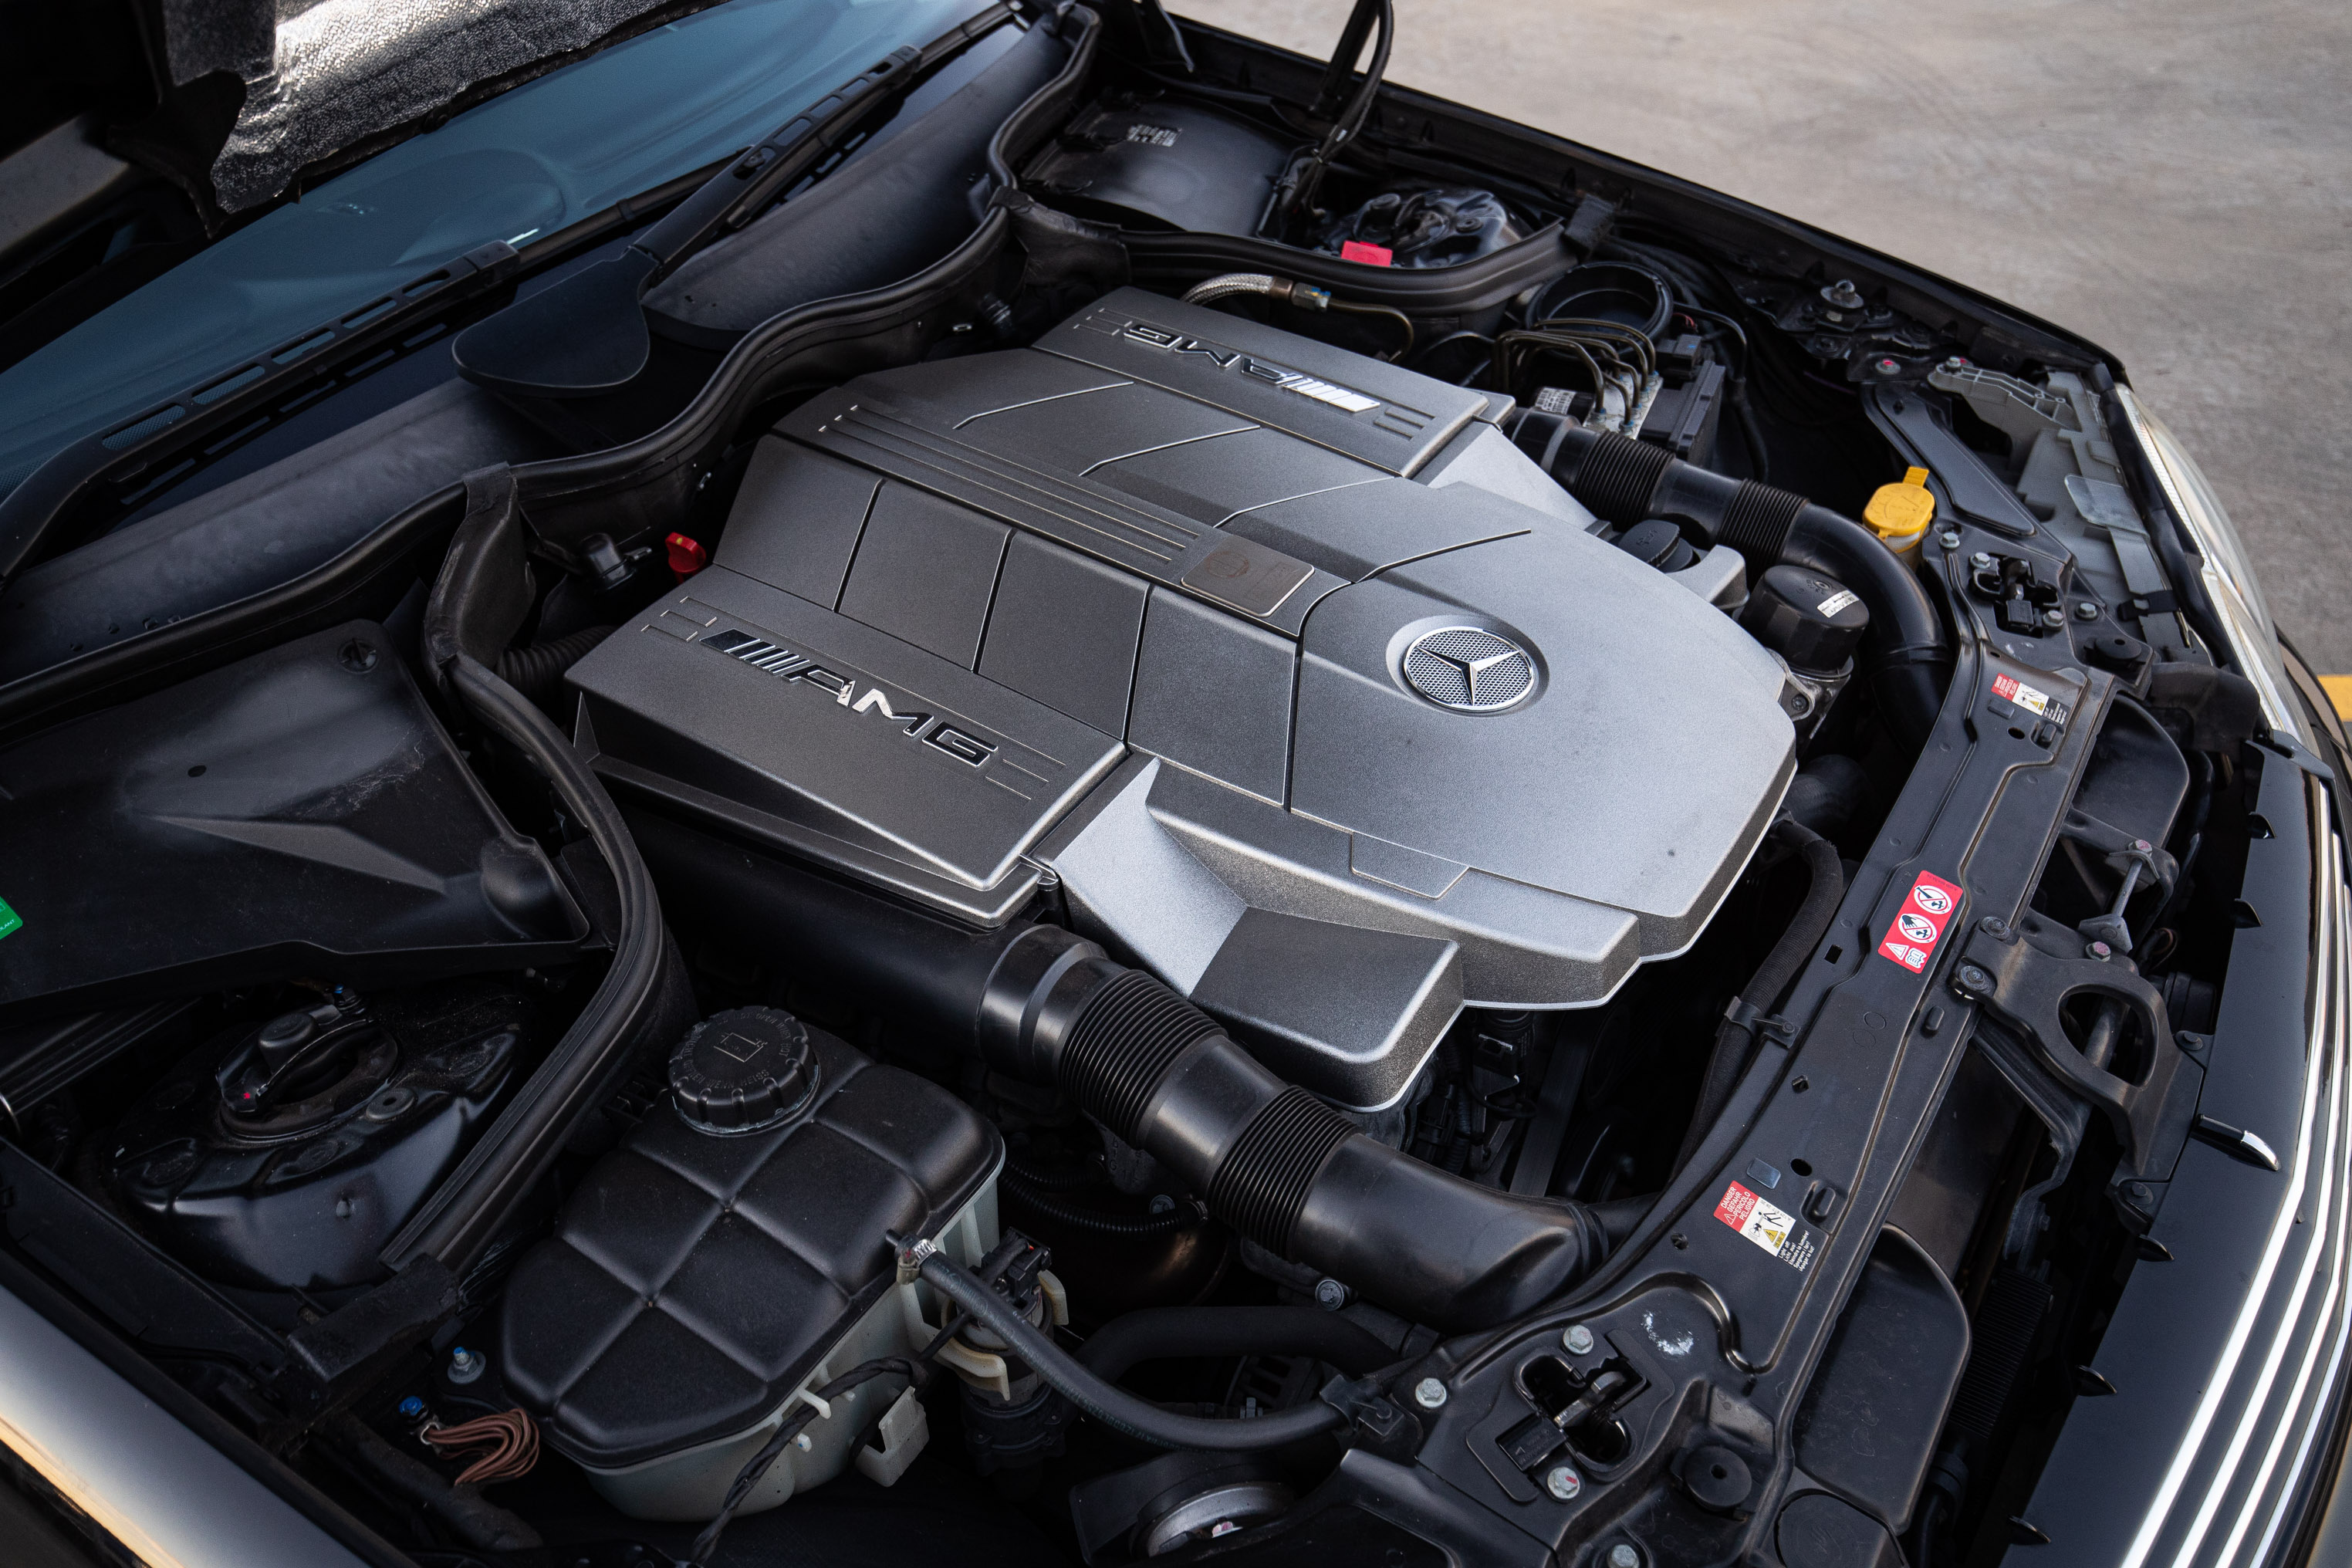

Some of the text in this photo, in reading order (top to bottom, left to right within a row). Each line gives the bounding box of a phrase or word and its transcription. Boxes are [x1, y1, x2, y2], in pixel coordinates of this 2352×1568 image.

[1124, 324, 1303, 384] AMG
[782, 664, 999, 769] AMG
[741, 1069, 770, 1086] HEISS
[1720, 1186, 1736, 1208] DANGER
[1726, 1191, 1742, 1212] GEFAHR
[1732, 1191, 1751, 1216] PERICOLO
[1739, 1198, 1755, 1220] PELIGRO
